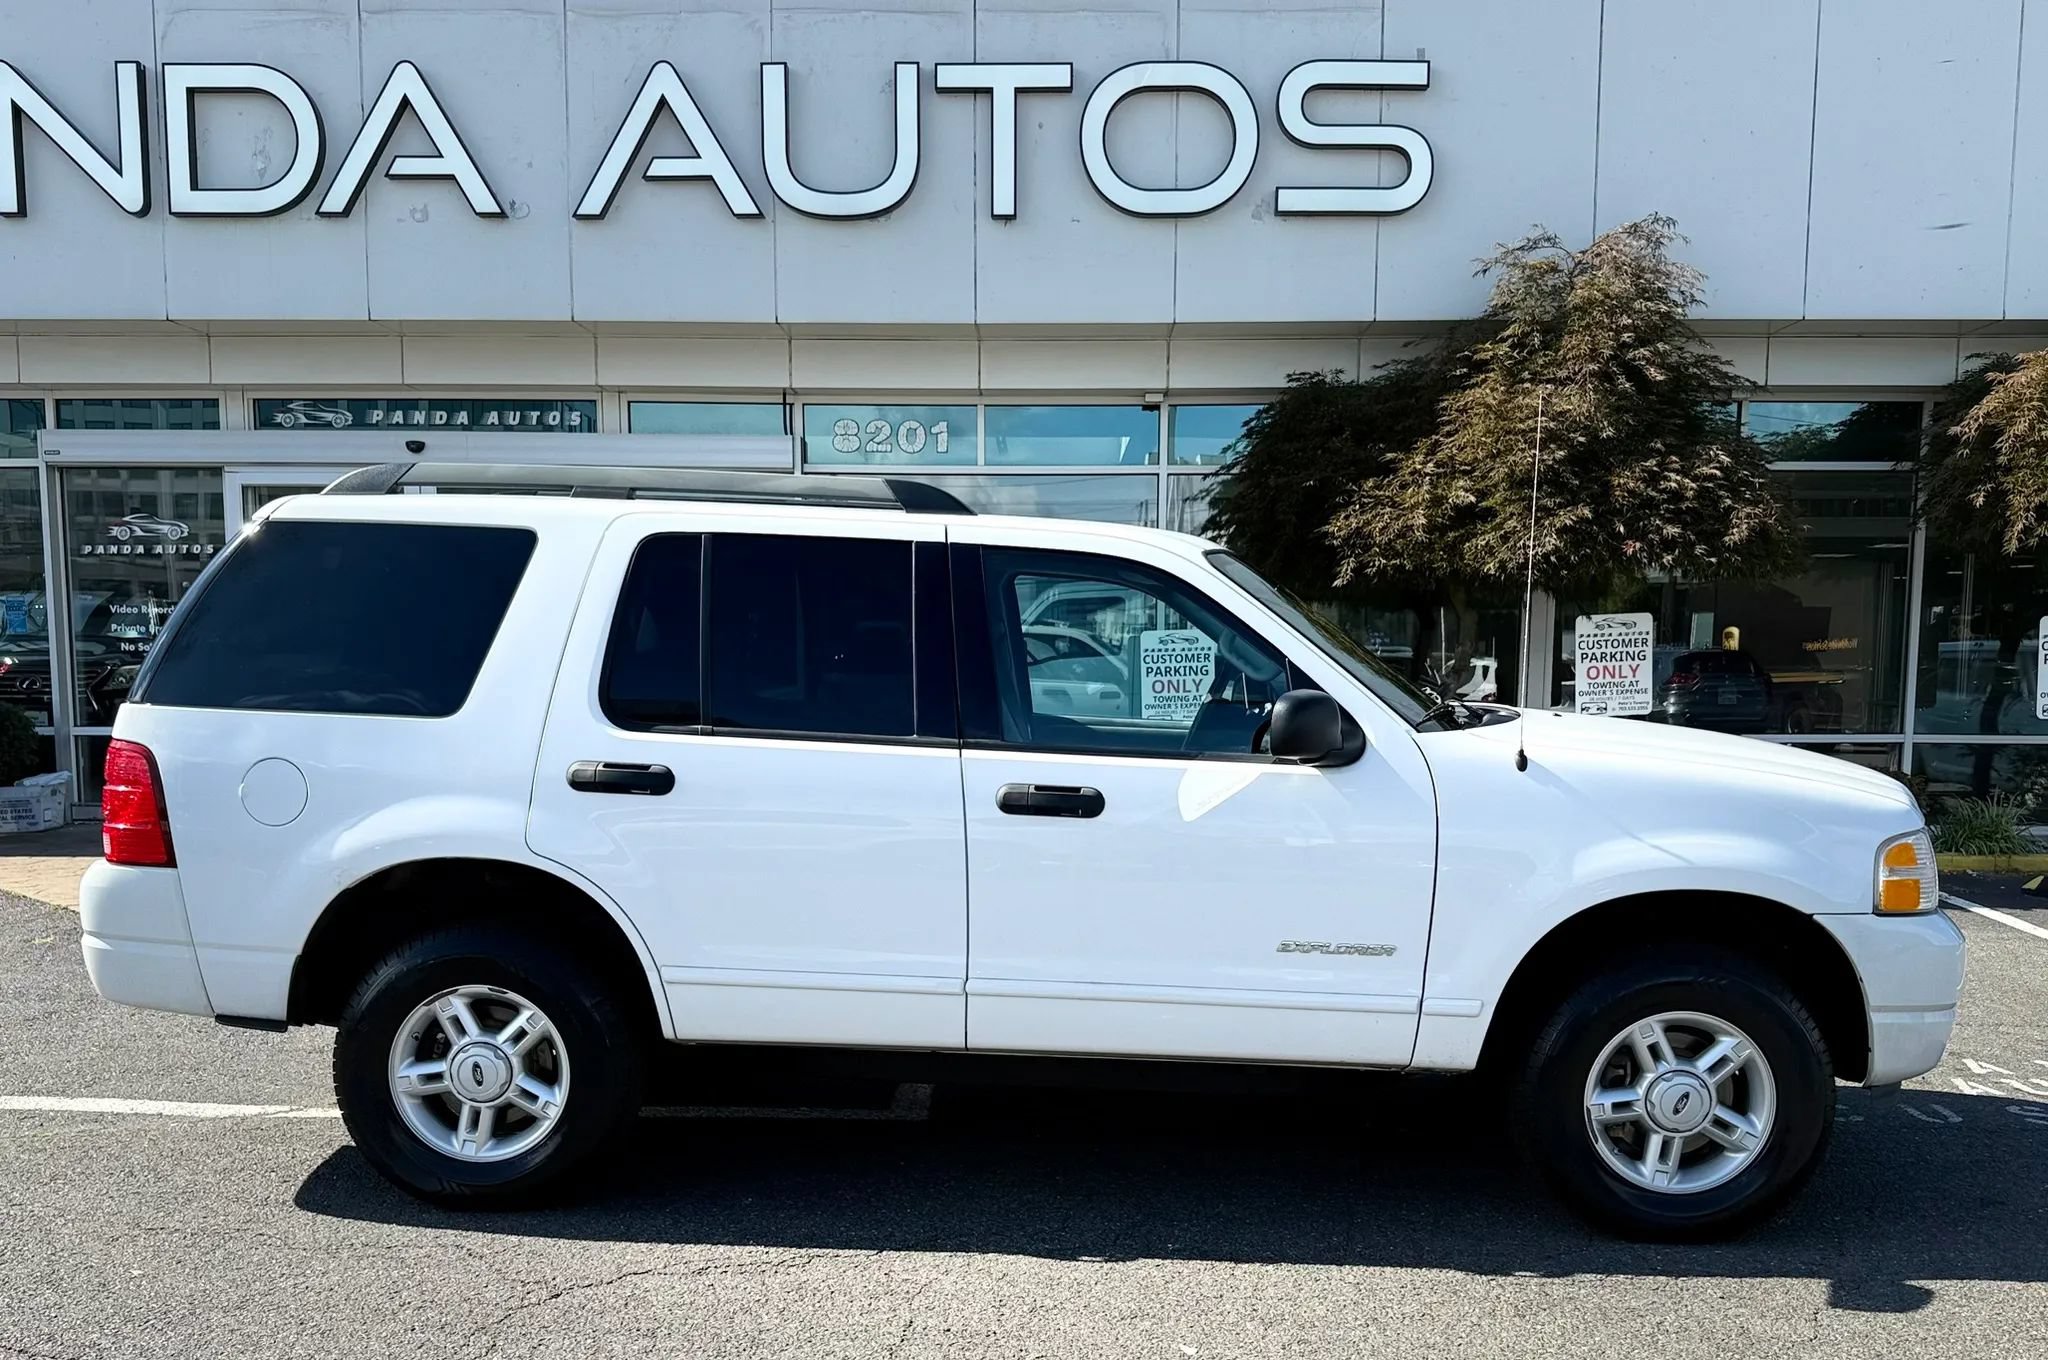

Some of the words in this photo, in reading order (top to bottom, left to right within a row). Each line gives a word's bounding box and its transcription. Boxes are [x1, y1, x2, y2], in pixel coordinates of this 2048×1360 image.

[0, 60, 509, 219] NDA
[572, 59, 1434, 220] AUTOS
[370, 410, 469, 425] PANDA
[486, 410, 582, 426] AUTOS
[832, 418, 949, 454] 8201
[84, 544, 144, 554] PANDA
[155, 544, 214, 554] AUTOS
[109, 604, 138, 614] Video
[111, 623, 146, 633] Private
[120, 642, 135, 651] No
[1578, 637, 1649, 650] CUSTOMER
[1143, 653, 1211, 665] CUSTOMER
[1580, 650, 1647, 664] PARKING
[1146, 665, 1209, 677] PARKING
[1586, 663, 1640, 680] ONLY
[1152, 678, 1203, 694] ONLY
[1587, 681, 1626, 690] TOWING
[1628, 680, 1640, 688] AT
[1578, 689, 1614, 697] OWNER'S
[1616, 687, 1649, 695] EXPENSE
[1153, 695, 1190, 703] TOWING
[1192, 694, 1203, 702] AT
[1144, 702, 1179, 710] OWNER'S
[1276, 940, 1397, 957] EXPLORER
